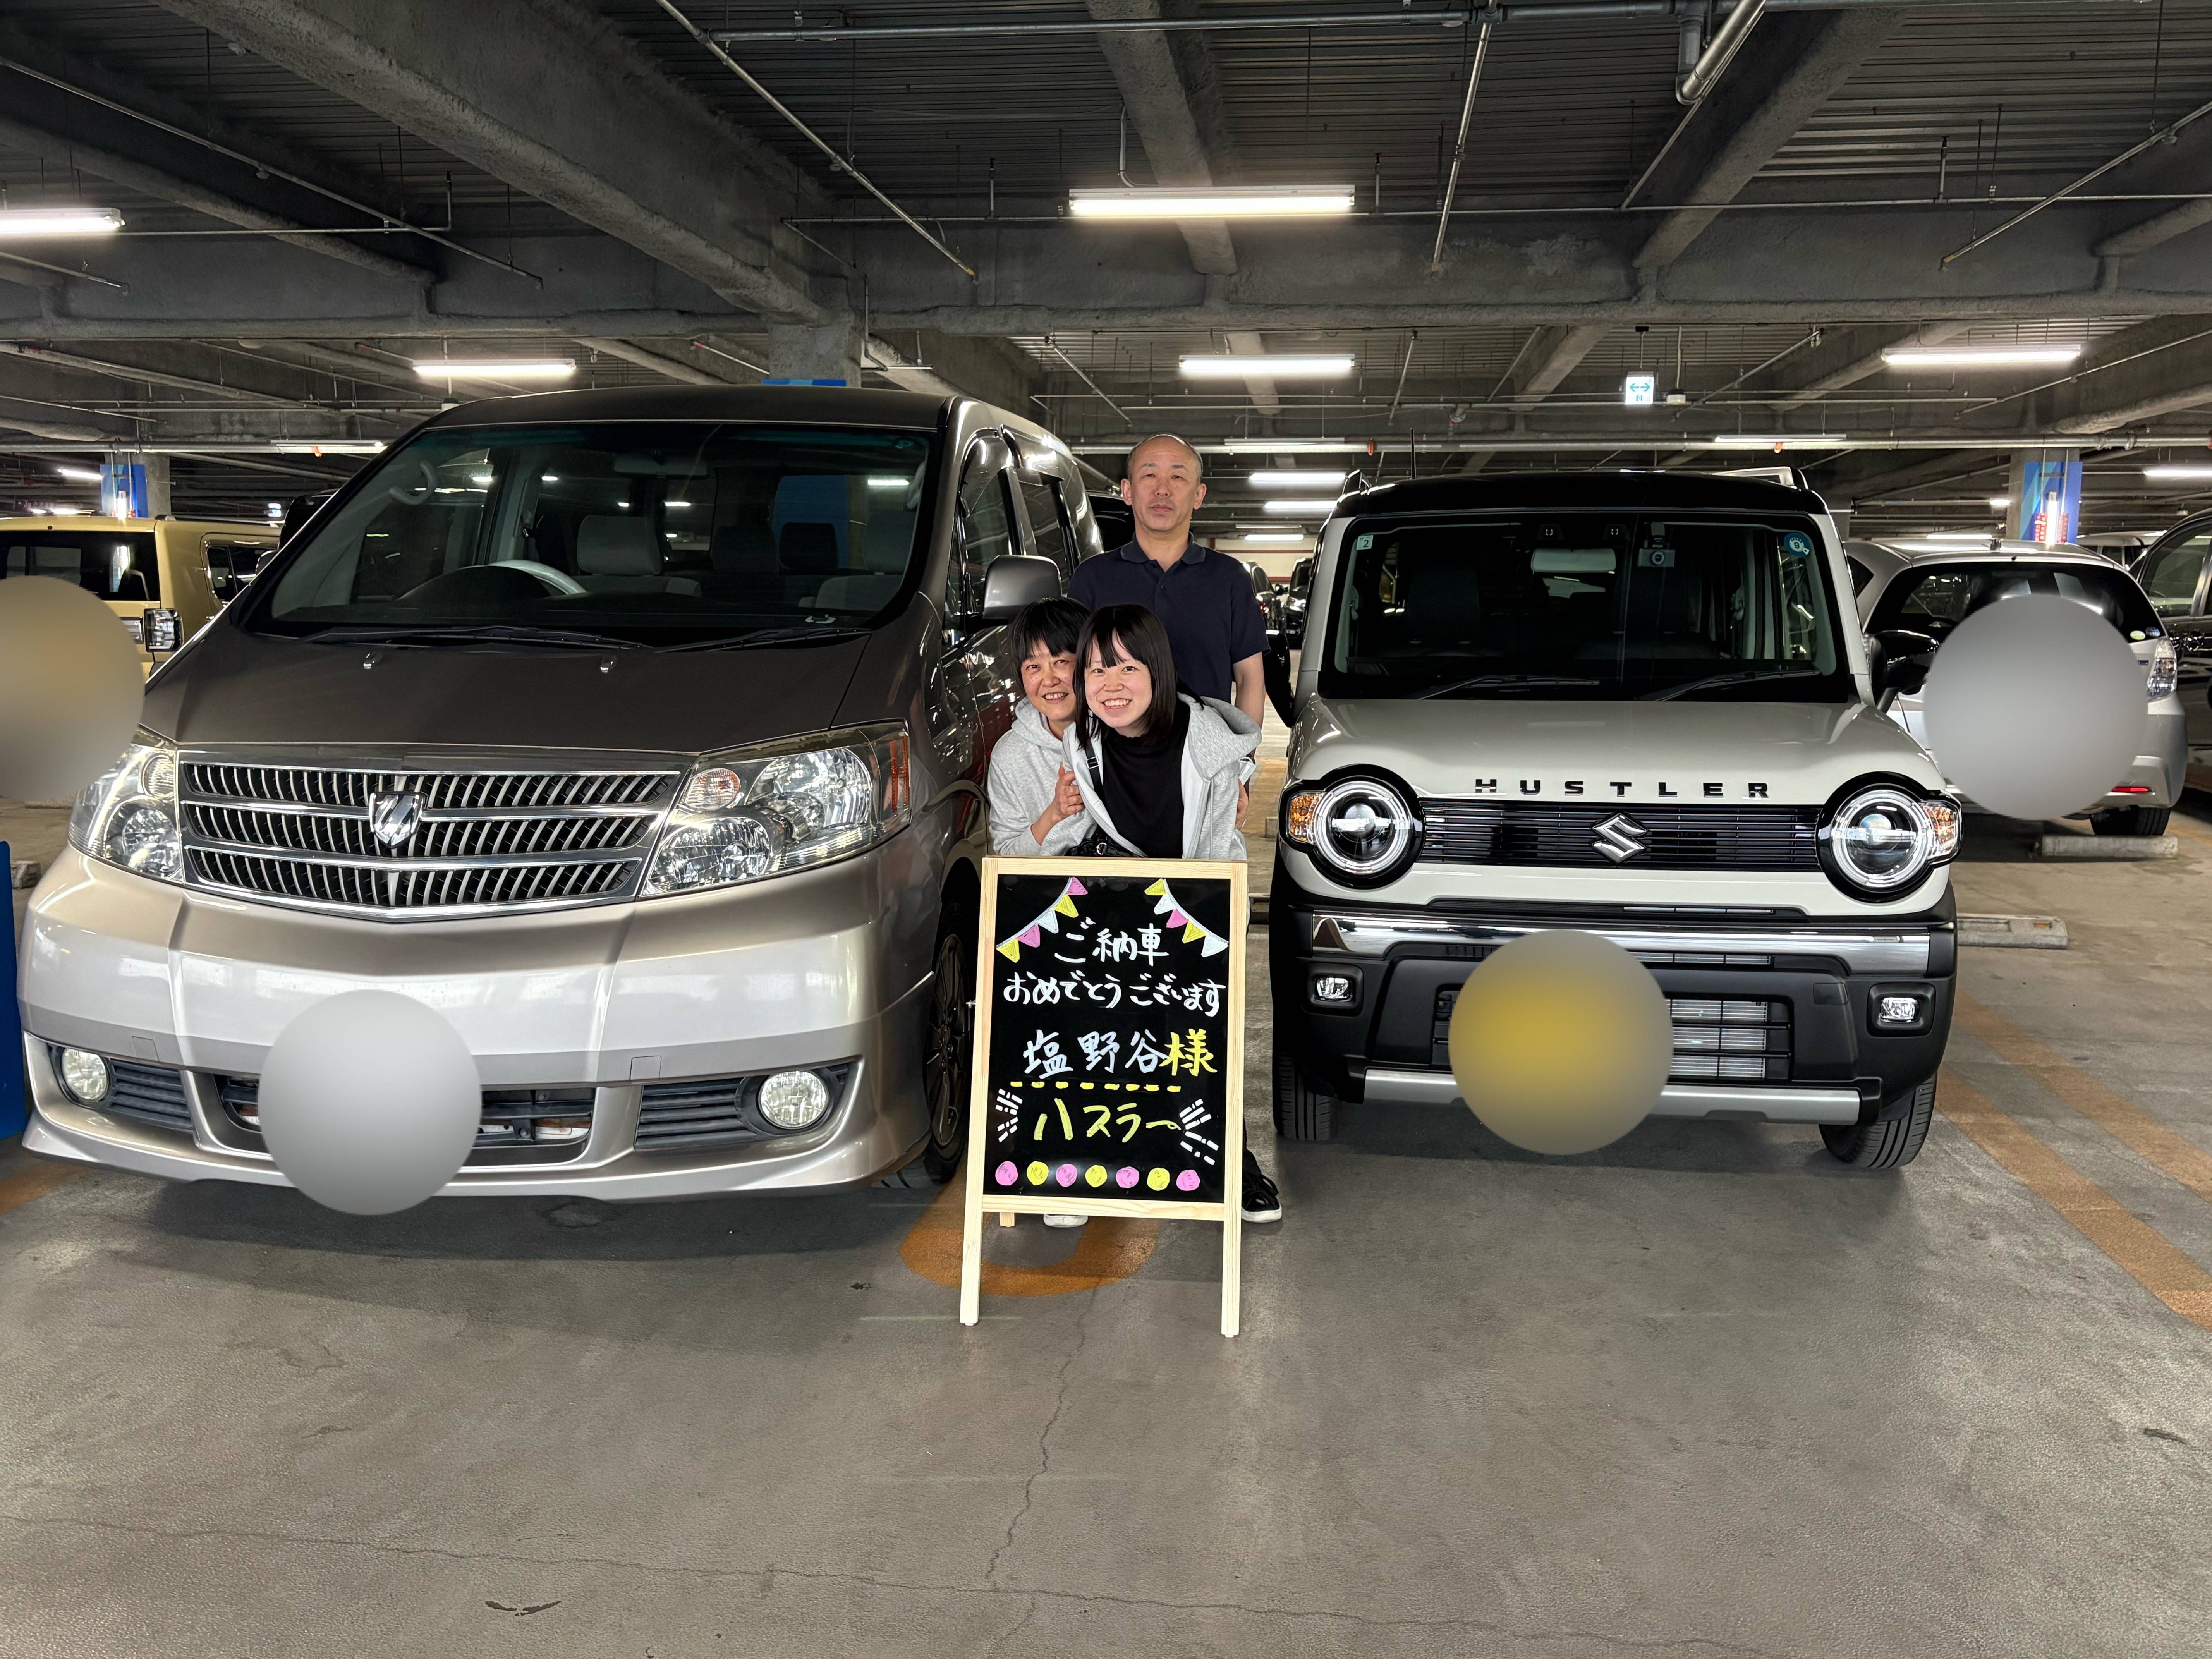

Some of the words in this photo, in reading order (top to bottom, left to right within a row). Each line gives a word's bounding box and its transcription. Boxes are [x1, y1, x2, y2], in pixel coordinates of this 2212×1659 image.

[1475, 778, 1769, 798] HUSTLER
[1054, 917, 1170, 967] ご納車
[1004, 970, 1226, 1016] おめでとうございます
